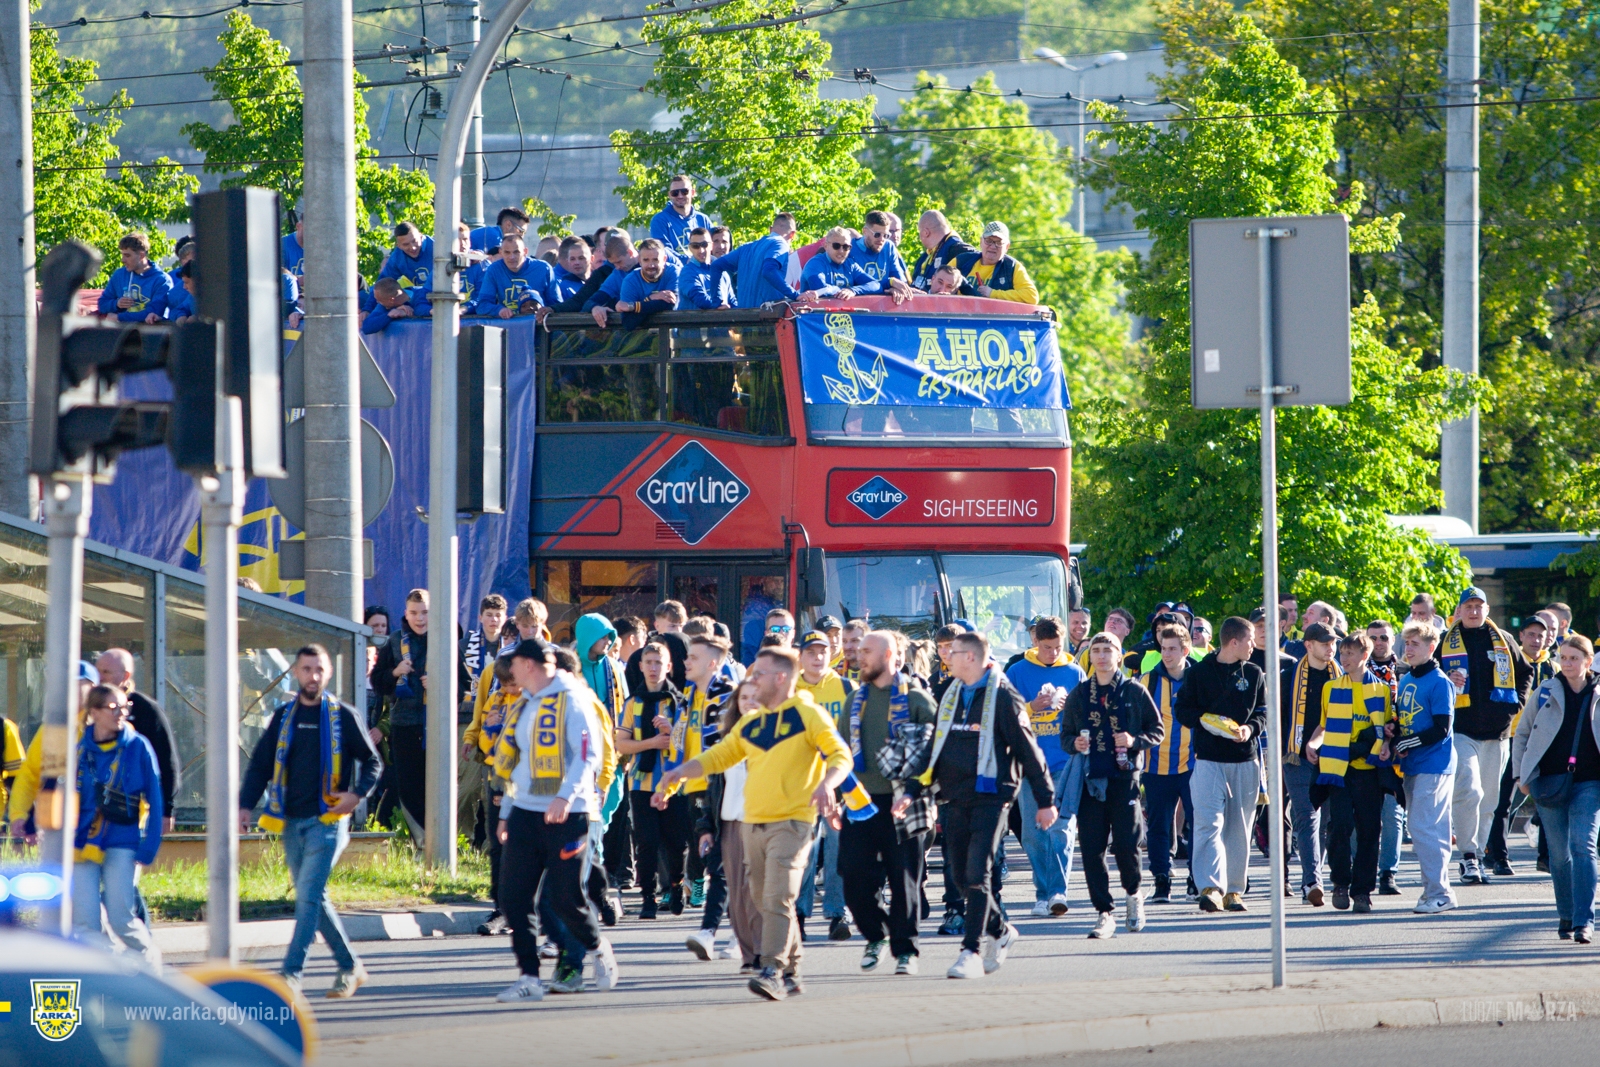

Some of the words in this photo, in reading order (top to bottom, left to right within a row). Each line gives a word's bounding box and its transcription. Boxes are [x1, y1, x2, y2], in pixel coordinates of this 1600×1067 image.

[914, 328, 1036, 370] AHOJ
[917, 366, 1042, 400] EKSTRAKLASO
[923, 499, 1038, 518] SIGHTSEEING
